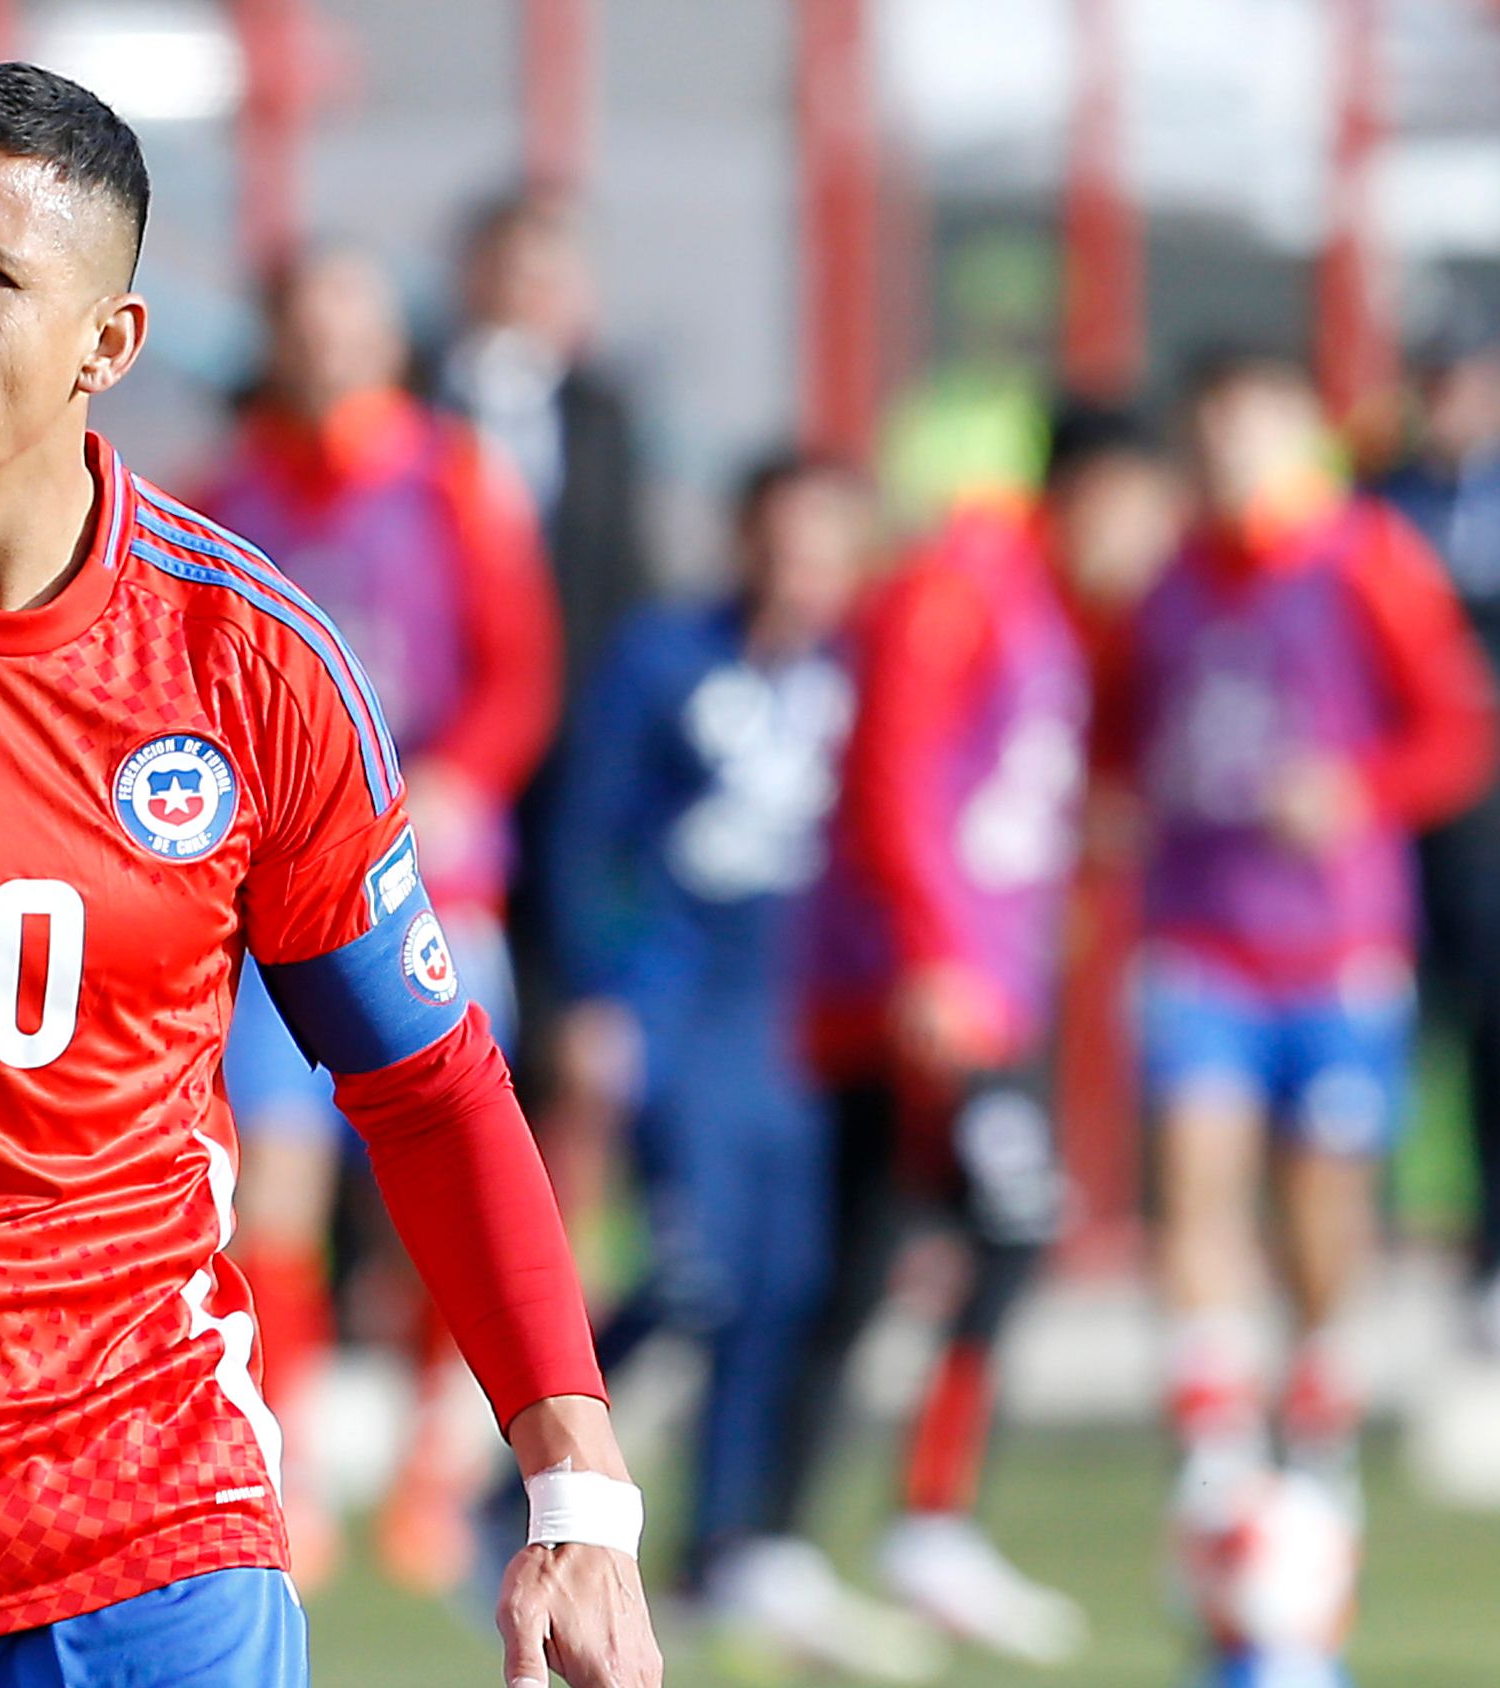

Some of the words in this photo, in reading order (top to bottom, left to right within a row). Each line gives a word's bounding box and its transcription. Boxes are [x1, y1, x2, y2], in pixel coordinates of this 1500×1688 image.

[118, 738, 176, 801] FEDERACION
[183, 738, 203, 755] DE
[202, 749, 232, 796] FUTBOL
[152, 836, 171, 854] DE
